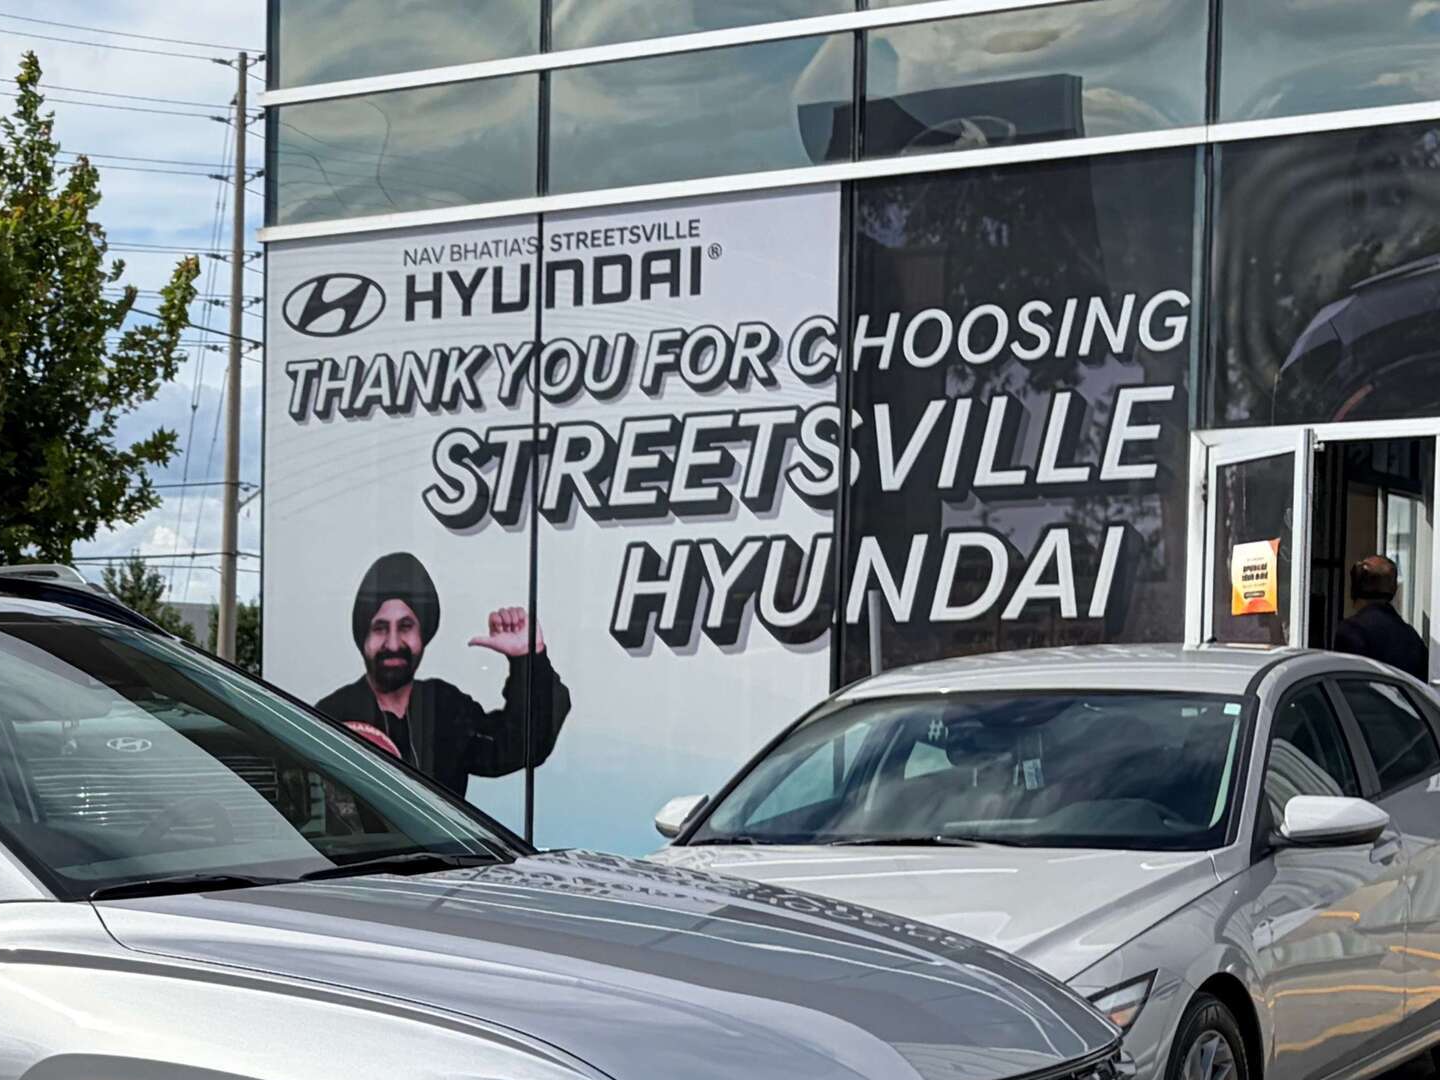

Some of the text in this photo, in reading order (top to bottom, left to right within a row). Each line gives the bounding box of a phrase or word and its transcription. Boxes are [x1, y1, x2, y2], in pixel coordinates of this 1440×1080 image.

[403, 218, 702, 267] NAV BHATIA'S STREETSVILLE
[285, 289, 1191, 423] THANK YOU FOR CHOOSING
[422, 385, 1178, 530] STREETSVILLE
[609, 523, 1136, 650] HYUNDAI
